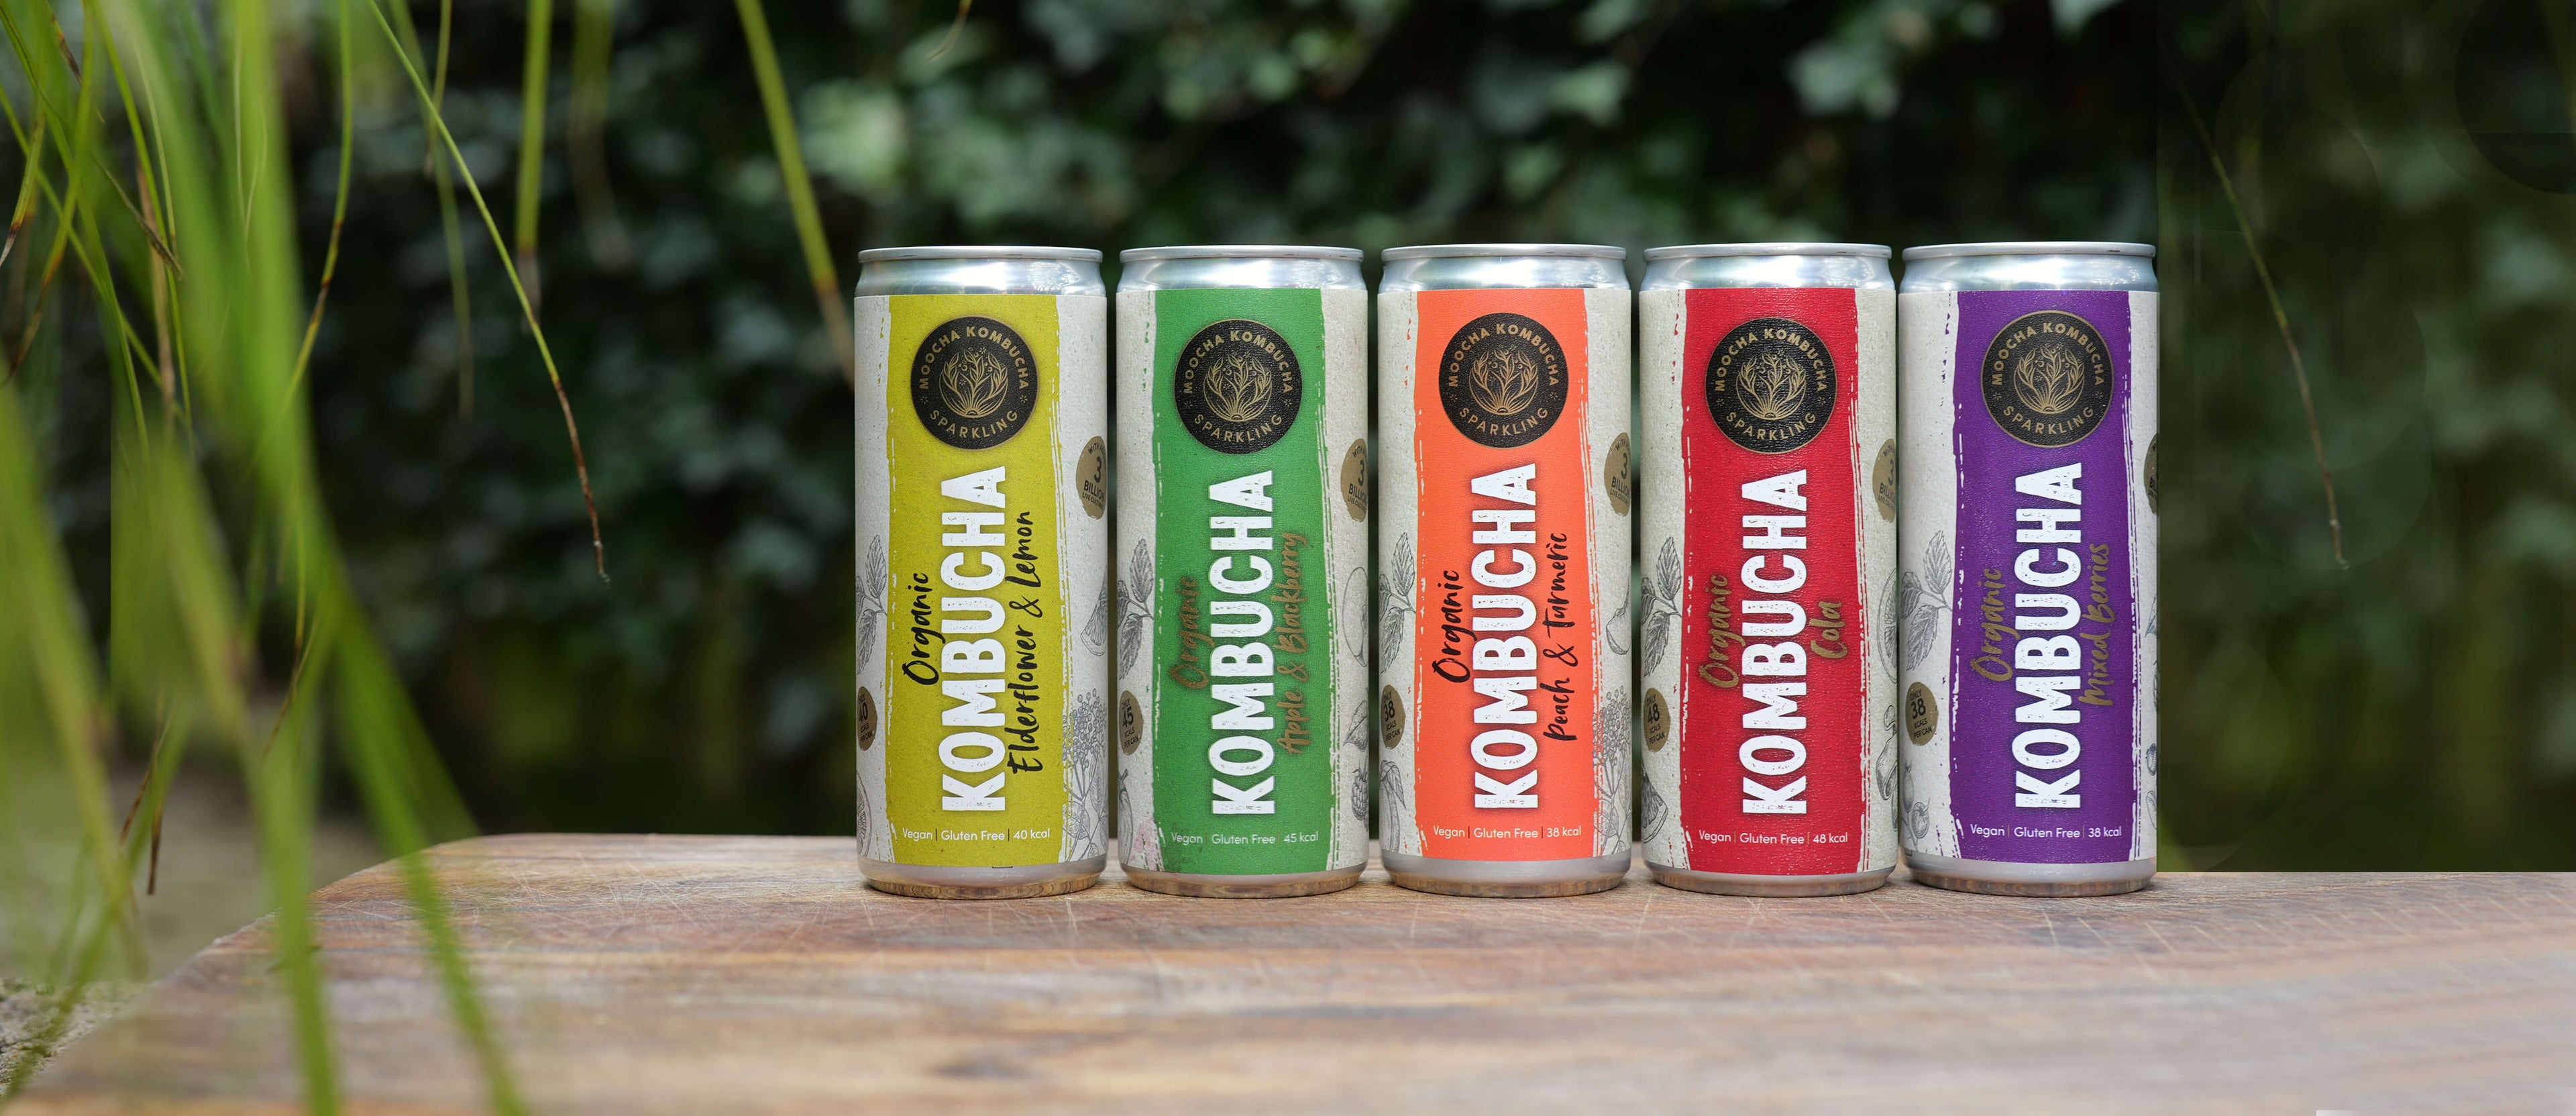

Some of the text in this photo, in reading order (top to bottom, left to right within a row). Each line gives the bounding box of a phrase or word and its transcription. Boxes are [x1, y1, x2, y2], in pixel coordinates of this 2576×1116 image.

[920, 327, 1029, 390] MOOCHA KOMBUCHA
[1183, 330, 1293, 394] MOOCHA KOMBUCHA
[1449, 323, 1559, 387] MOOCHA KOMBUCHA
[1715, 328, 1827, 392] MOOCHA KOMBUCHA
[1991, 323, 2104, 386] MOOCHA KOMBUCHA
[930, 411, 1018, 438] SPARKLING
[1195, 414, 1282, 442] SPARKLING
[1460, 407, 1548, 436] SPARKLING
[1726, 412, 1816, 440] SPARKLING
[2003, 405, 2094, 435] SPARKLING
[1094, 456, 1102, 483] 3
[1358, 460, 1364, 486] 3
[1621, 453, 1627, 480] 3
[1888, 458, 1894, 486] 3
[1349, 483, 1366, 503] BILLIO
[1880, 483, 1895, 502] BILL
[1542, 533, 1575, 639] Turmeric
[902, 572, 945, 685] Organic
[1170, 576, 1215, 689] Organic
[1432, 570, 1477, 682] Organic
[1470, 463, 1538, 809] KOMBUCHA
[1699, 574, 1746, 688] Organic
[1809, 601, 1847, 658] Cola
[1970, 569, 2020, 681] Organic
[2012, 462, 2082, 808] KOMBUCHA
[2078, 543, 2116, 705] Mixed Berries
[938, 466, 1006, 811] KOMBUCHA
[1004, 511, 1043, 774] Elderflower & Lemon
[1209, 470, 1275, 814] KOMBUCHA
[1271, 533, 1311, 754] Apple & Blackberry
[1739, 469, 1807, 814] KOMBUCHA
[1544, 644, 1578, 667] &
[860, 703, 867, 722] 40
[1122, 706, 1133, 727] 45
[1384, 701, 1395, 721] 38
[1648, 703, 1660, 723] 48
[1911, 698, 1926, 719] 38
[1130, 735, 1138, 744] CAN
[1392, 728, 1400, 738] CAN
[1656, 732, 1665, 741] CAN
[1922, 726, 1932, 735] CAN
[902, 827, 1050, 840] Vegan Gluten Free 40 kcal
[1172, 832, 1318, 845] Vegan Gluten Free 45 kcal
[1433, 825, 1581, 838] Vegan Gluten Free 38 kcal
[1699, 830, 1847, 844] Vegan Gluten Free 48 kcal
[1970, 824, 2121, 838] Vegan Gluten Free 38 kcal
